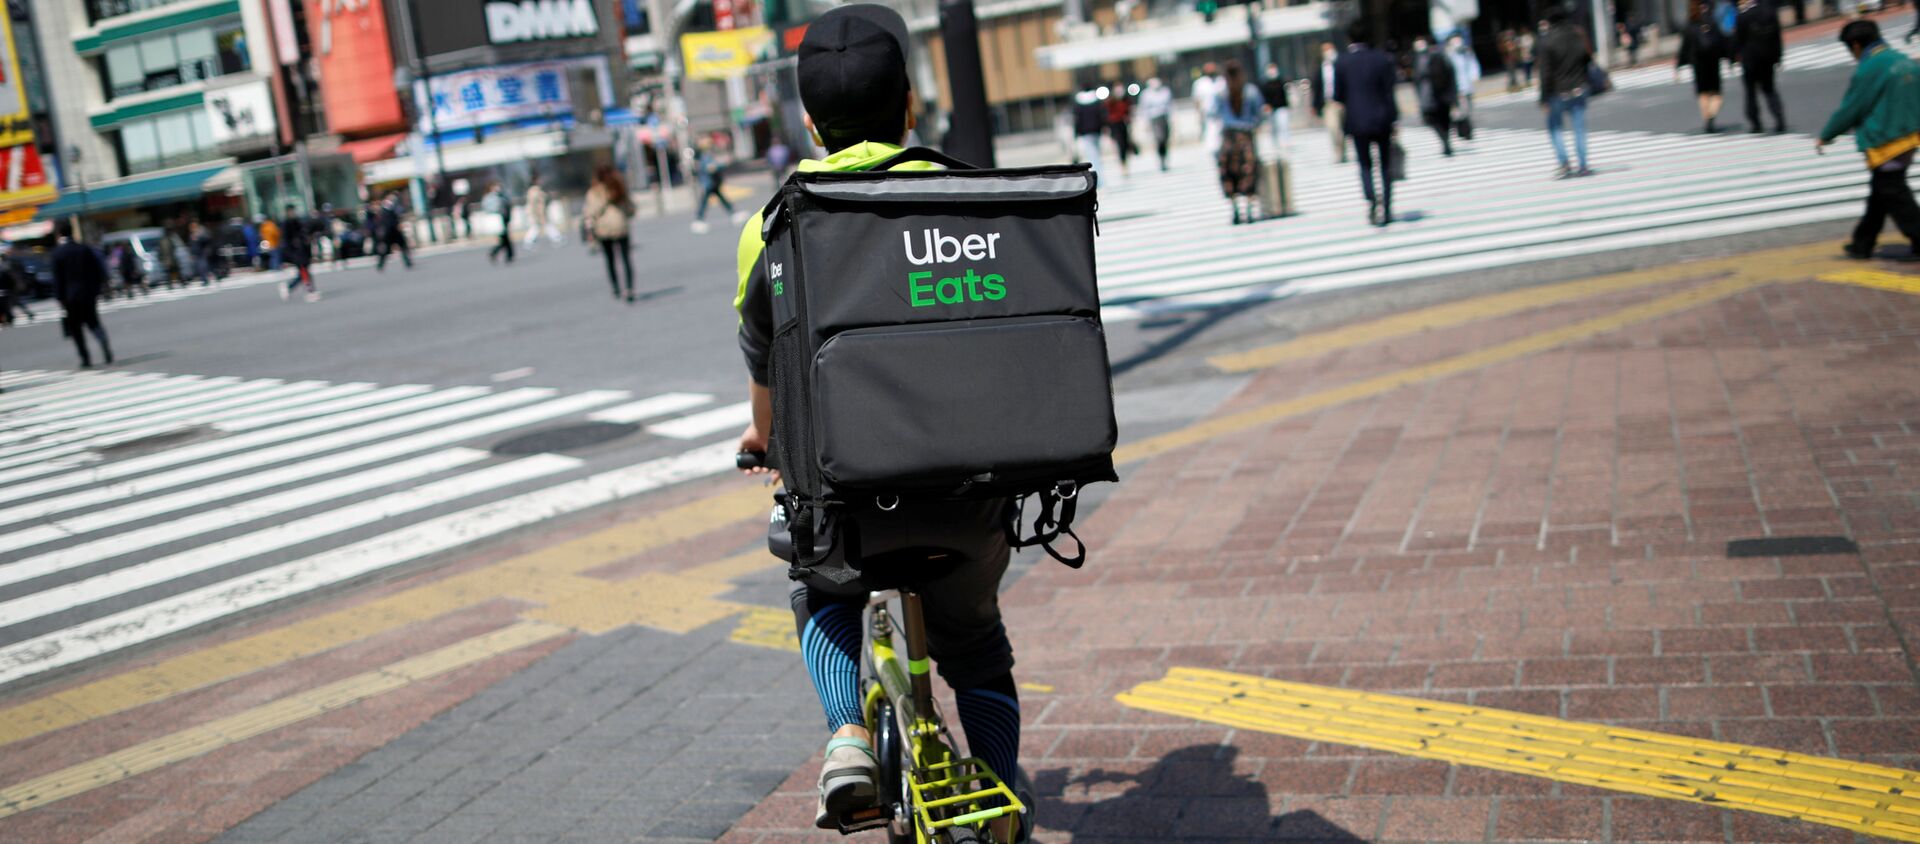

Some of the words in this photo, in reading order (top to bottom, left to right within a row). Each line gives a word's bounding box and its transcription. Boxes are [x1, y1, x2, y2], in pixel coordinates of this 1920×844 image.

[485, 0, 600, 43] DMM
[903, 228, 1001, 266] Uber
[908, 269, 1007, 307] Eats
